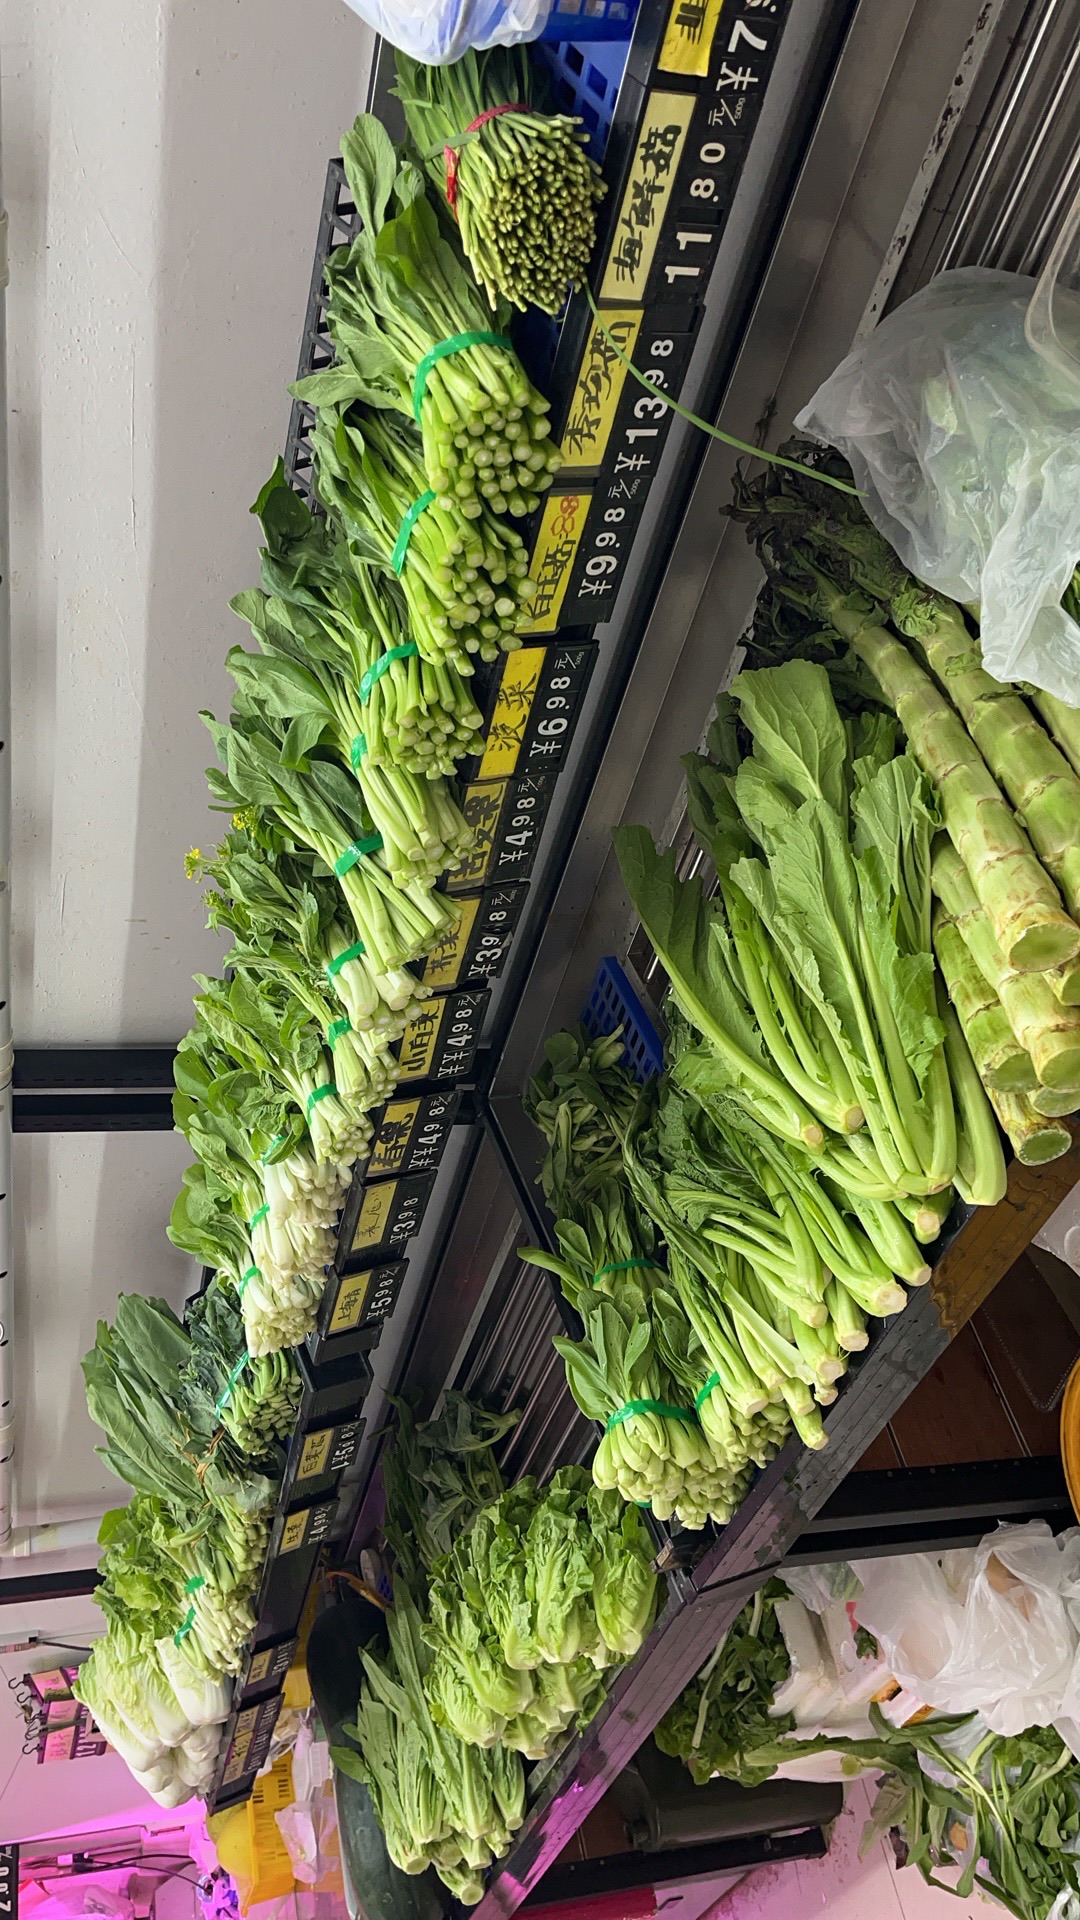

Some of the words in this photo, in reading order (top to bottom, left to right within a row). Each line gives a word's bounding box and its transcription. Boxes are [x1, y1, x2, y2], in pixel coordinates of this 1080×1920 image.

[612, 124, 683, 285] 海鲜菇
[565, 321, 636, 456] 秀珍菇
[402, 1000, 440, 1072] 小白菜
